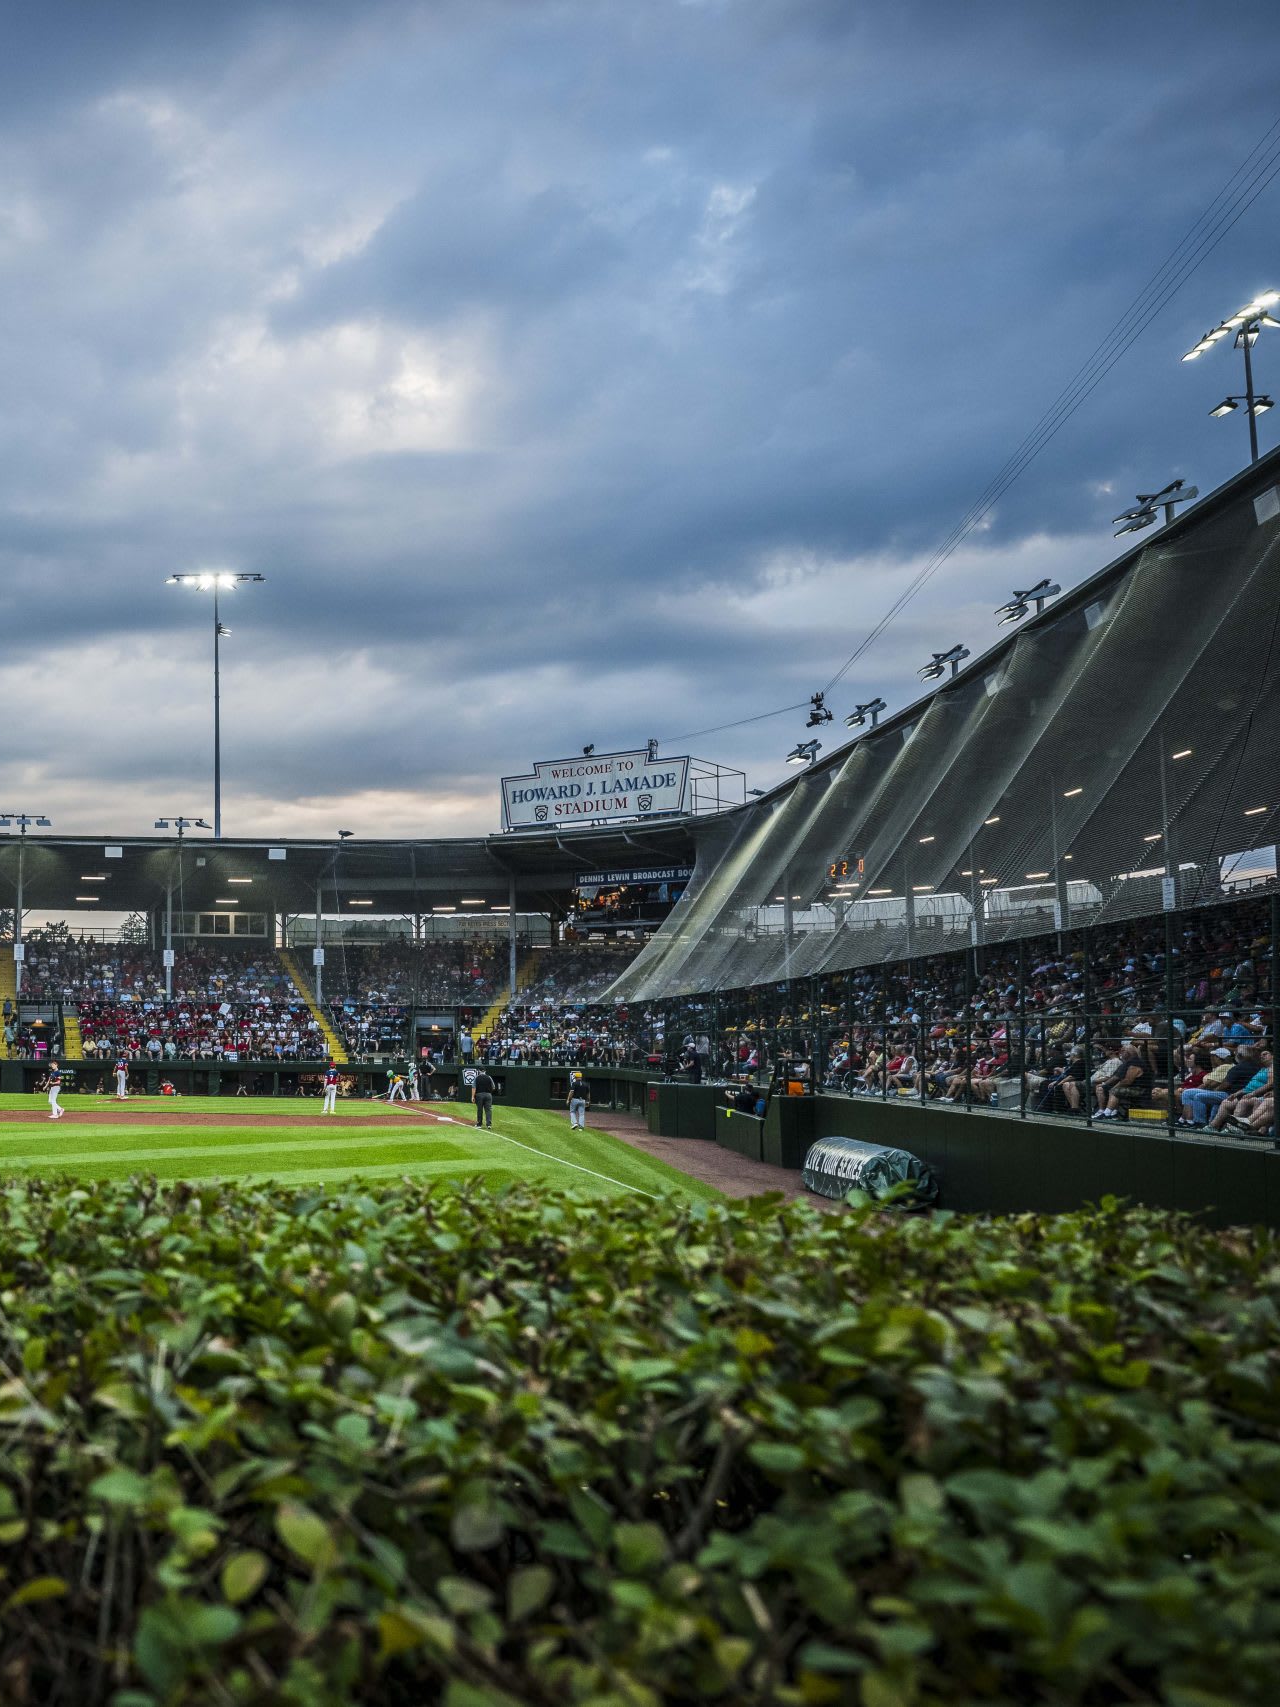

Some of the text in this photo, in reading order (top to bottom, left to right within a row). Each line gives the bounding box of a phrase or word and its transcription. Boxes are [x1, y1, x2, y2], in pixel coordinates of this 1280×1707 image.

[551, 760, 634, 779] WELCOME TO
[511, 772, 677, 804] HOWARD J. LAMADE
[554, 796, 628, 816] STADIUM
[579, 869, 694, 883] DENNIS LEWIN BROADCAST BOO
[830, 864, 836, 877] 2
[841, 861, 847, 875] 2
[329, 1074, 334, 1082] 7
